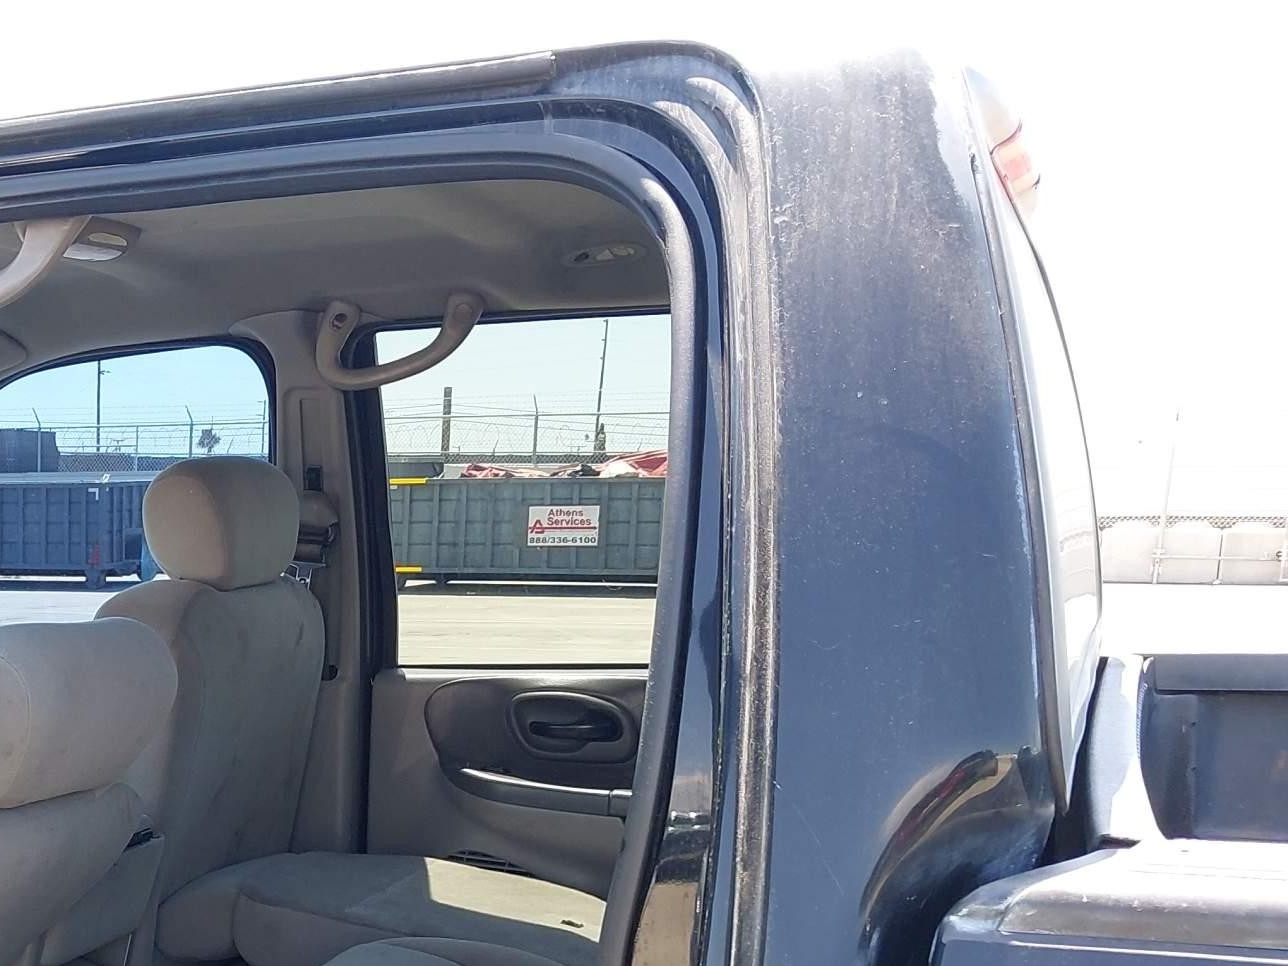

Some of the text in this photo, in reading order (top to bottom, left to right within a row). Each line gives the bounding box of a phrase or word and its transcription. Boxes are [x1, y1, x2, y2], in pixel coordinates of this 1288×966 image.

[548, 508, 584, 517] Athens
[547, 517, 592, 526] Services
[529, 536, 596, 544] 888/336-6100
